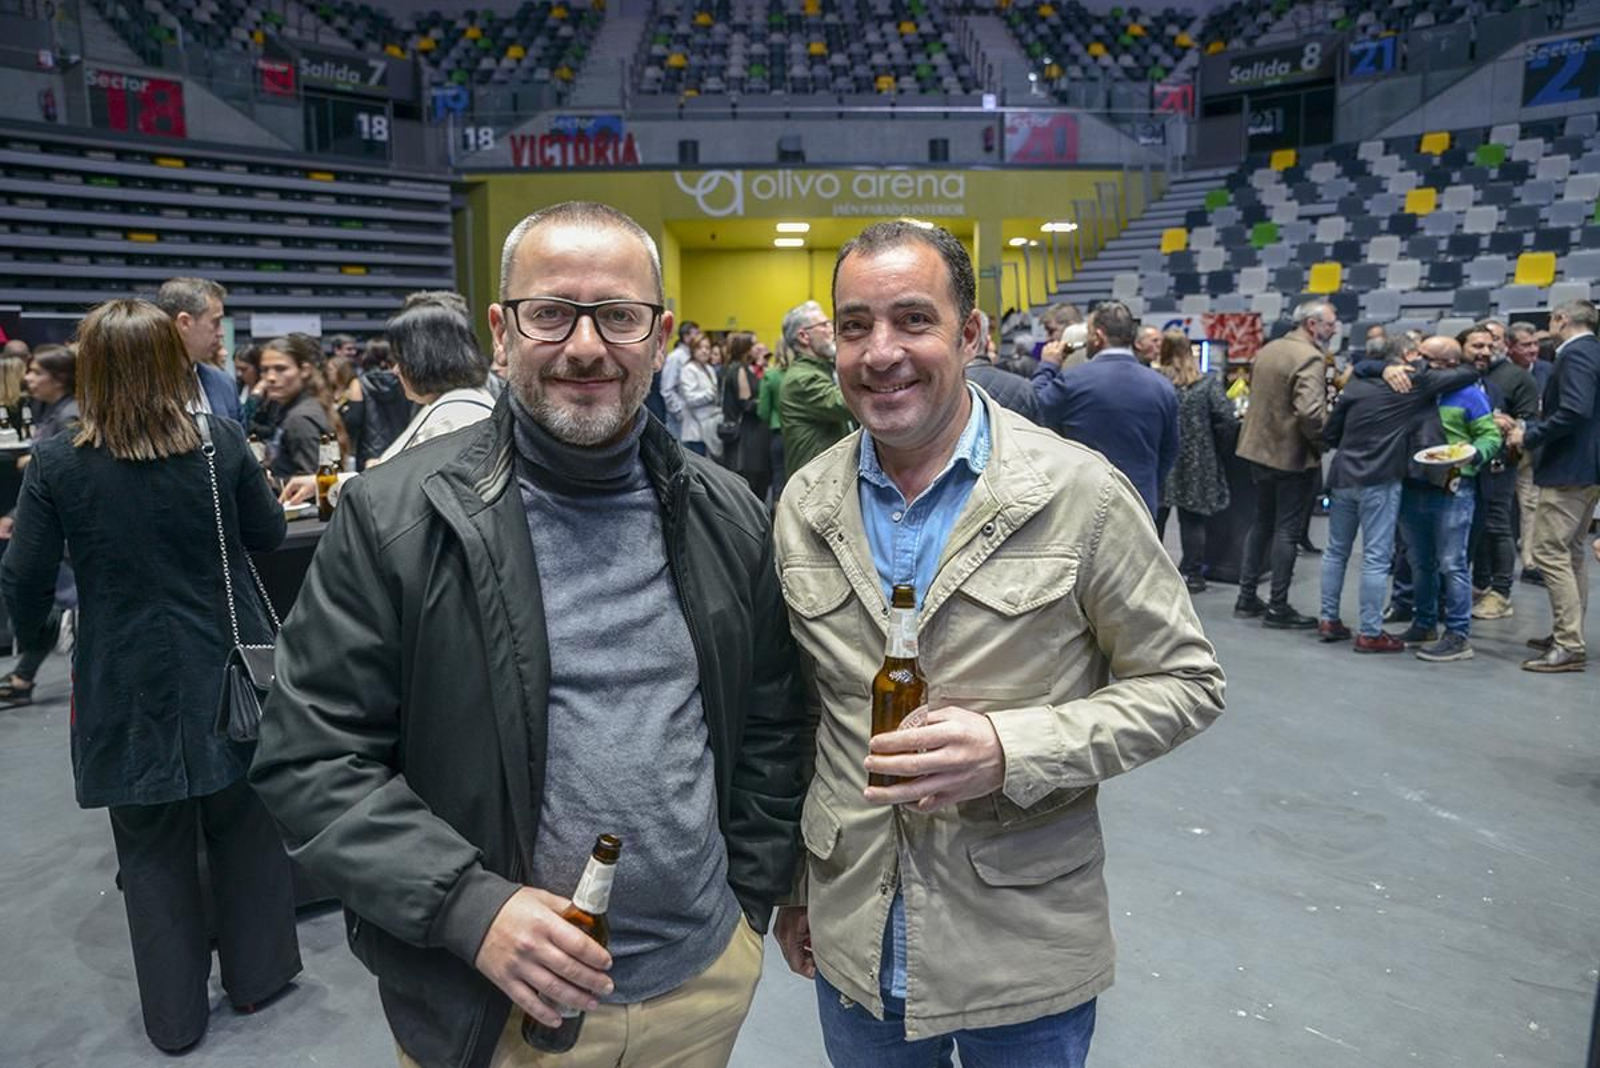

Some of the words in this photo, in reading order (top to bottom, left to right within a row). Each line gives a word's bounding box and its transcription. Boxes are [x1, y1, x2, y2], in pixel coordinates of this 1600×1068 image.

[1228, 59, 1291, 84] Salida
[1301, 43, 1322, 70] 8
[1525, 39, 1593, 61] Sector
[84, 68, 150, 93] Sector
[300, 58, 361, 84] Salida
[367, 59, 387, 87] 7
[1526, 36, 1600, 106] 2
[100, 71, 187, 138] 18
[357, 112, 389, 141] 18
[464, 126, 495, 151] 18
[508, 132, 642, 168] VICTORIA
[752, 169, 840, 200] olivo
[852, 171, 966, 200] arena
